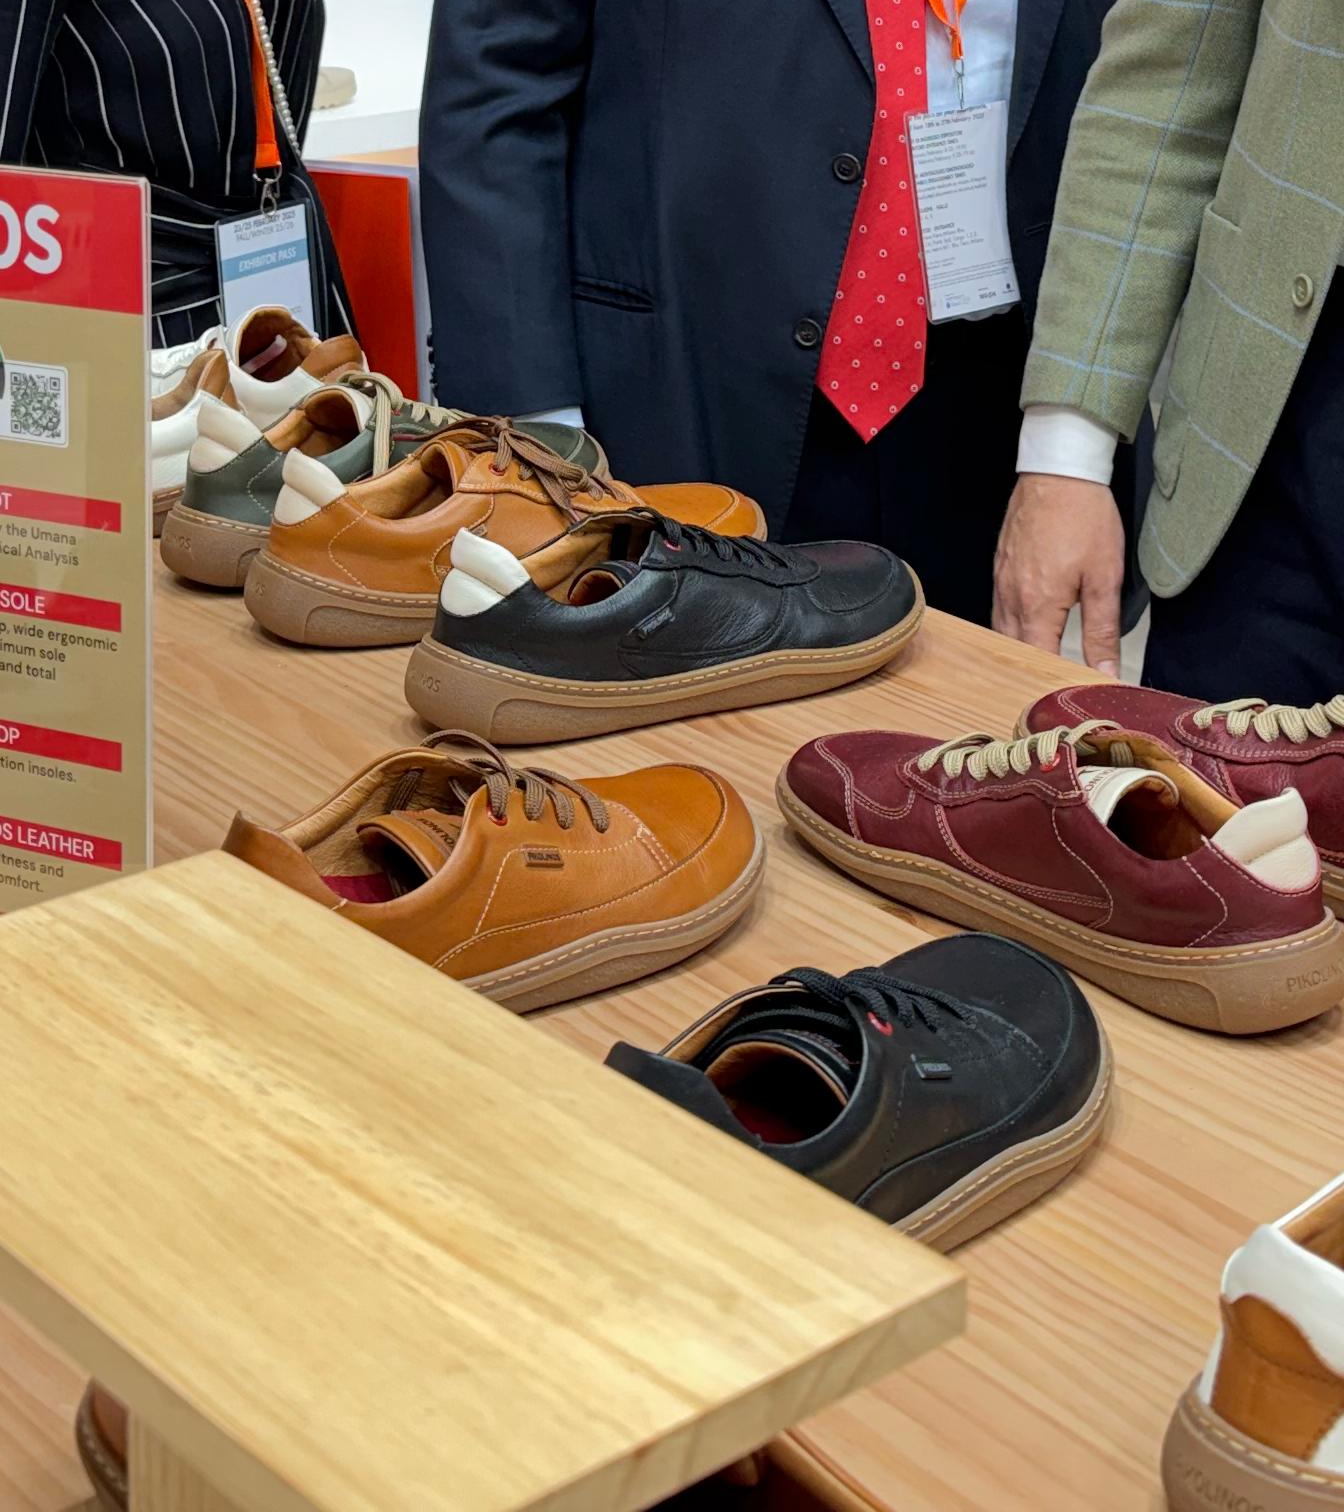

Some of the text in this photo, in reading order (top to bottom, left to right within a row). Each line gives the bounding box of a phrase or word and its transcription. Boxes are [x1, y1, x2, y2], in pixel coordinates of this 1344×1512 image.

[6, 523, 27, 538] the
[31, 527, 77, 546] Umana
[25, 545, 79, 566] Analysis
[0, 589, 46, 615] SOLE
[13, 624, 44, 639] wide
[47, 631, 118, 652] ergonomic
[39, 647, 67, 663] sole
[26, 664, 56, 681] total
[28, 760, 77, 783] insoles.
[17, 825, 95, 860] LEATHER
[40, 863, 64, 878] and
